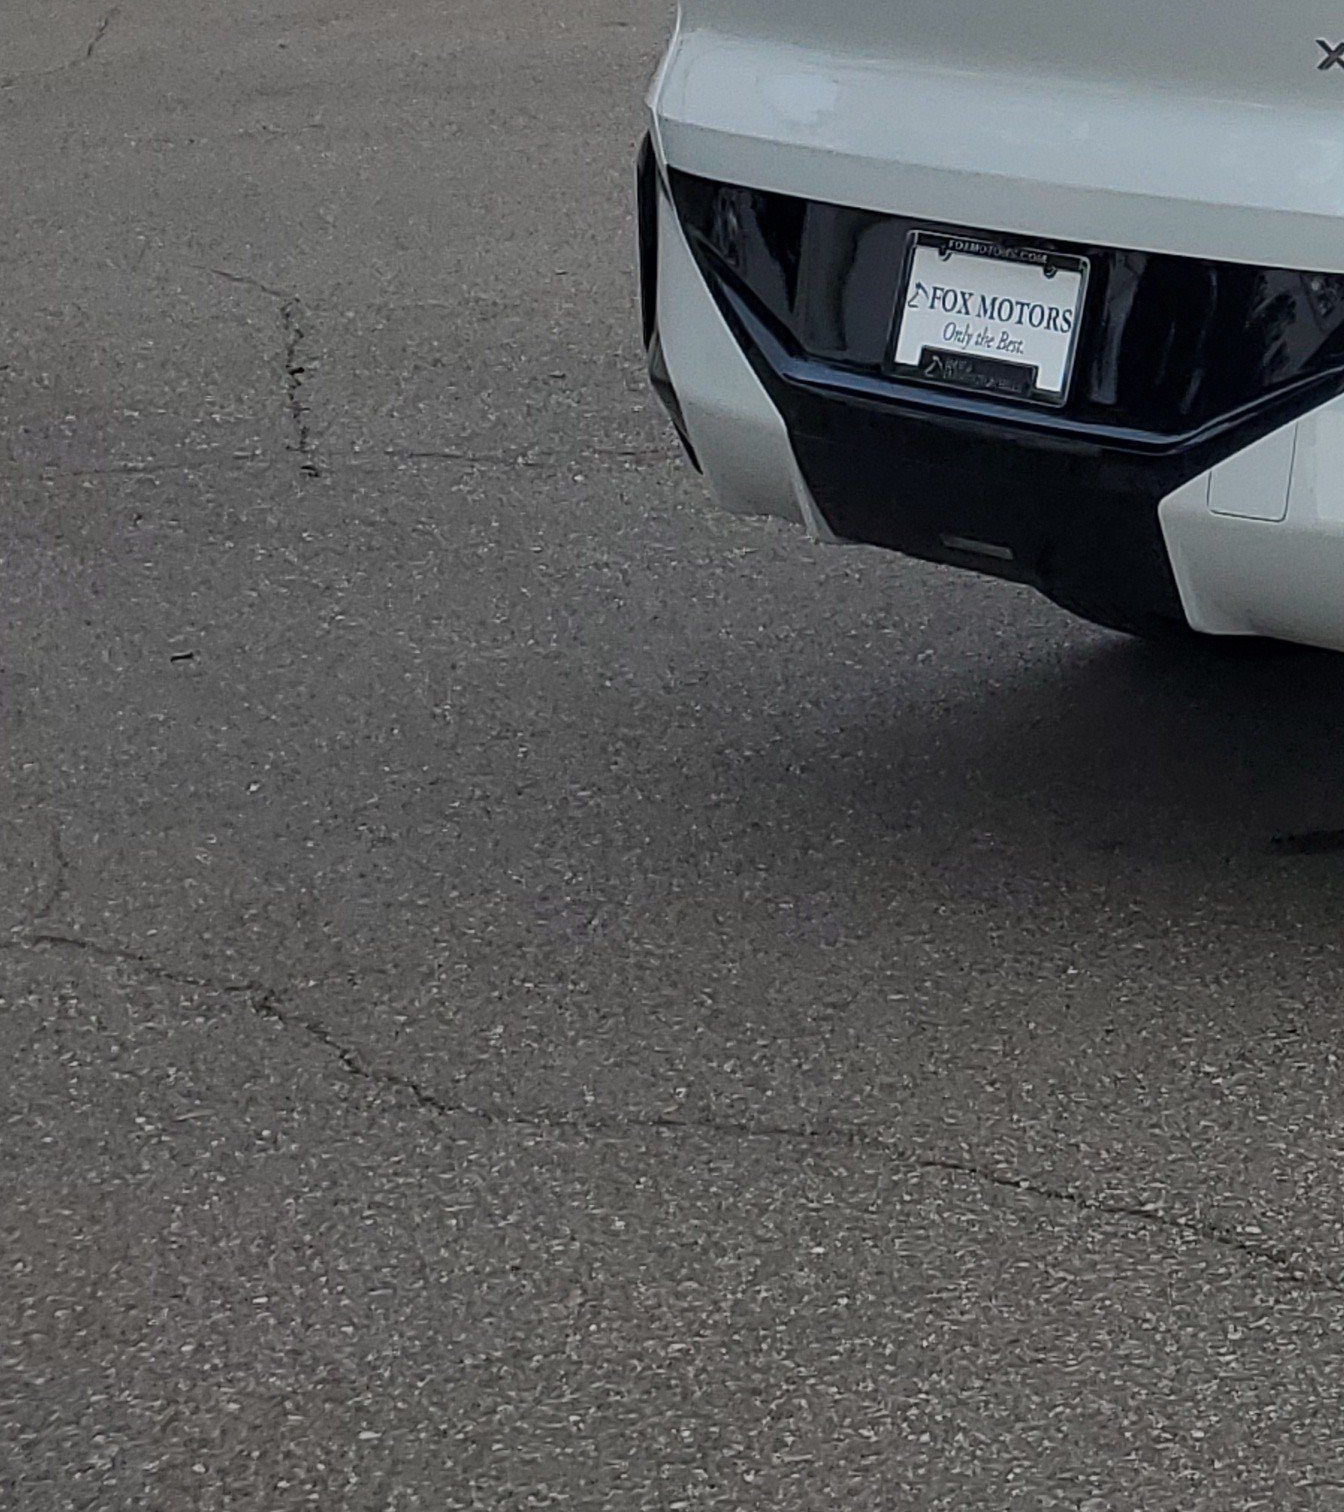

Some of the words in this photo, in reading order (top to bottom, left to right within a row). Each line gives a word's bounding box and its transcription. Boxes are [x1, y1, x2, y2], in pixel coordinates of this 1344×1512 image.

[928, 286, 975, 317] FOX
[976, 294, 1073, 334] MOTORS
[942, 321, 973, 351] Only
[975, 326, 995, 350] the
[995, 330, 1025, 355] Best.
